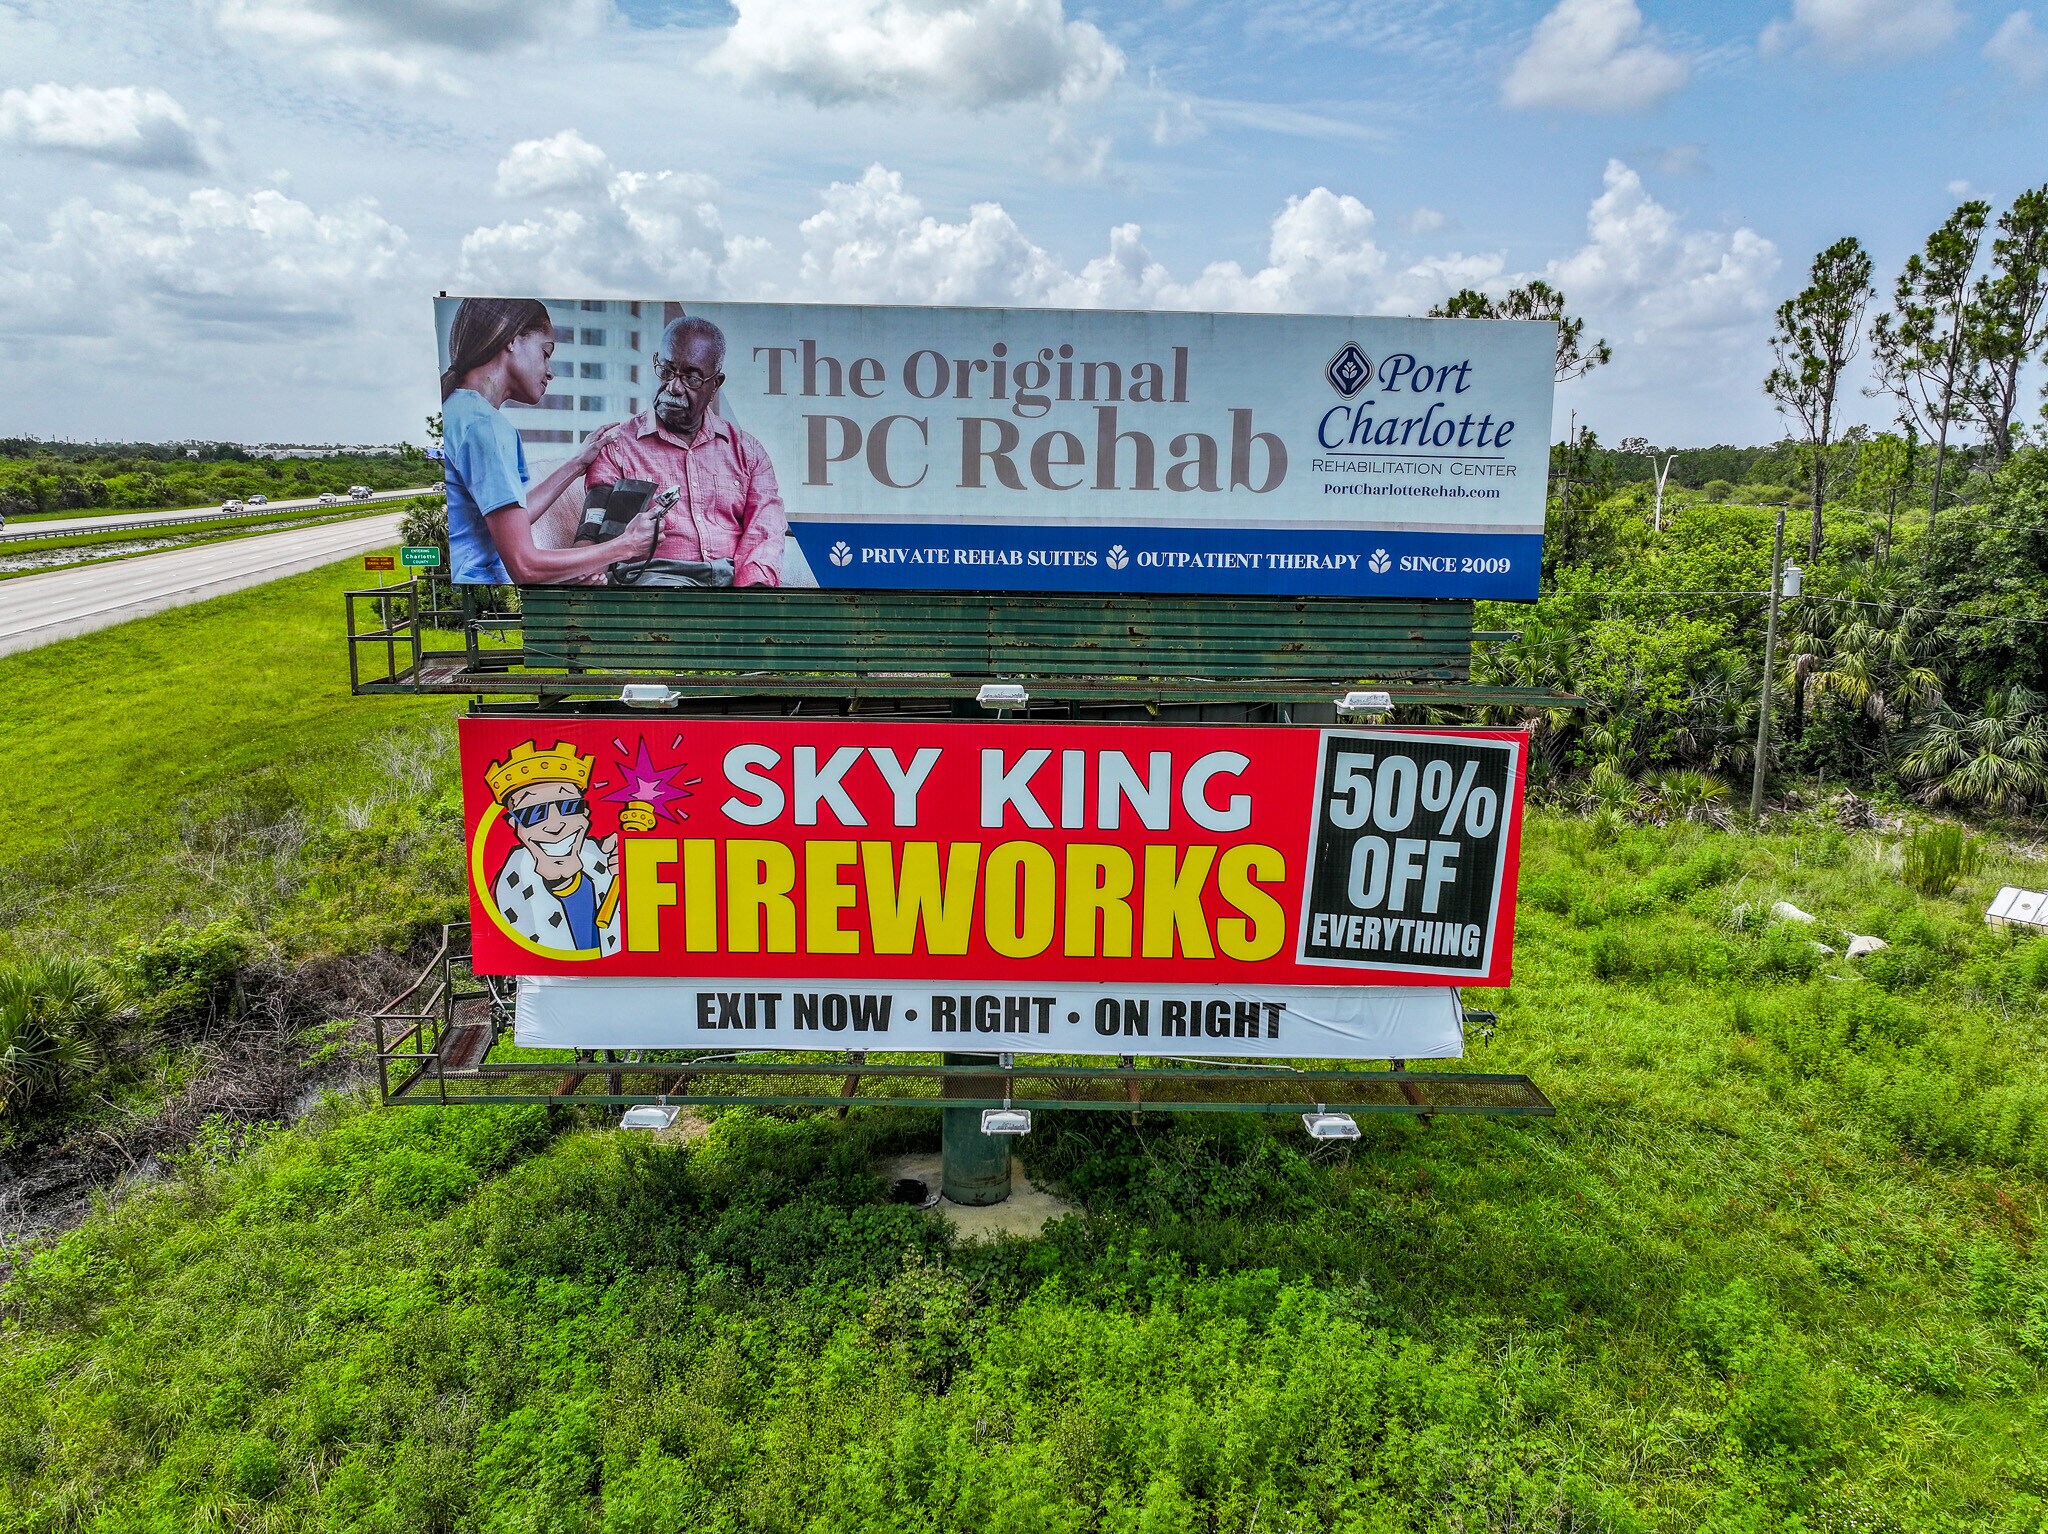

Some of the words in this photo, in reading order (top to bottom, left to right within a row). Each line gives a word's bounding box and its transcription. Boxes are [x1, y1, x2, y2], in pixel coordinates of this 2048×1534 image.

[753, 340, 885, 398] The
[903, 343, 1190, 418] Original
[1378, 353, 1472, 394] Port
[1318, 400, 1515, 449] Charlotte
[802, 415, 929, 489] PC
[956, 406, 1288, 493] Rehab
[1312, 459, 1442, 475] REHABILITATION
[1450, 462, 1517, 477] CENTER
[1324, 483, 1500, 499] PortCharlotteRehab.com
[861, 548, 949, 564] PRIVATE
[953, 549, 1023, 566] REHAB
[1027, 550, 1098, 567] SUITES
[1136, 551, 1263, 569] OUTPATIENT
[1266, 553, 1361, 570] THERAPY
[1400, 556, 1457, 573] SINCE
[1461, 557, 1512, 574] 2009
[721, 743, 943, 827] SKY
[979, 748, 1253, 833] KING
[1329, 750, 1498, 839] 50%
[1347, 835, 1461, 914] OFF
[623, 838, 1287, 963] FIREWORKS
[1311, 913, 1481, 959] EVERYTHING
[696, 992, 782, 1030] EXIT
[793, 993, 893, 1032] NOW
[931, 994, 1056, 1034] RIGHT
[1094, 998, 1150, 1036] ON
[1161, 999, 1287, 1039] RIGHT
